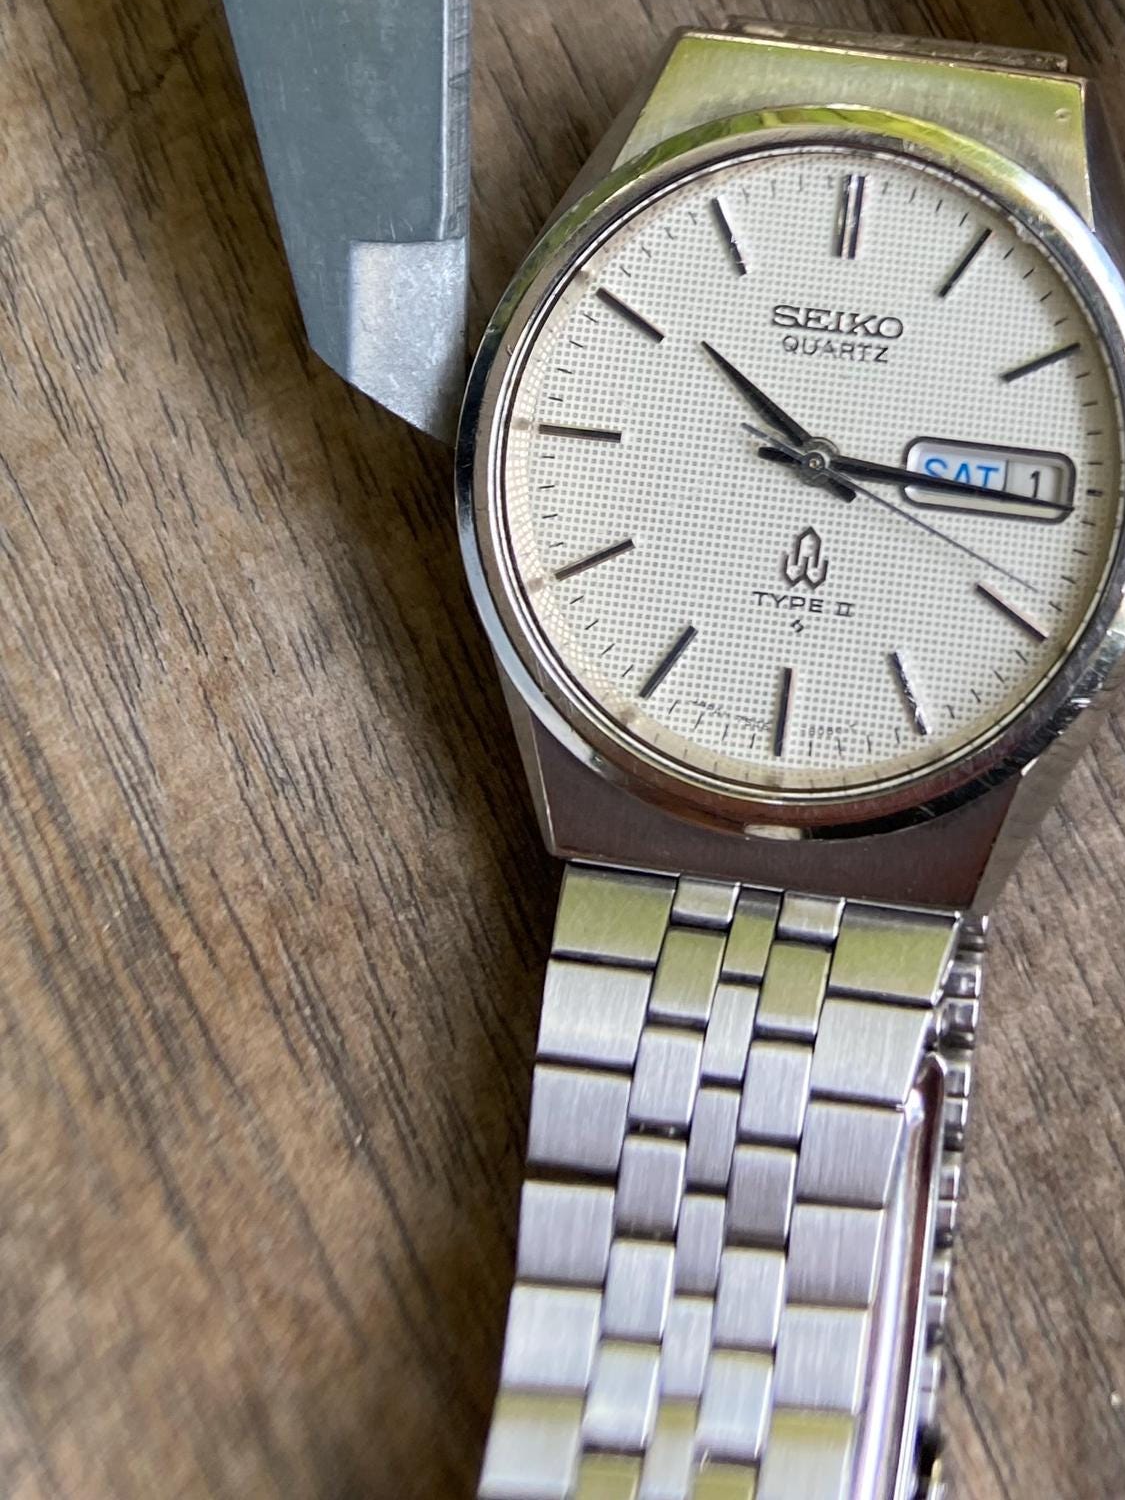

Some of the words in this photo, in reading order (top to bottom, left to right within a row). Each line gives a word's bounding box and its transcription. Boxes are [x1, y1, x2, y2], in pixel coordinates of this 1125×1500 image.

[772, 304, 904, 340] SEIKO
[781, 334, 889, 364] QUARTZ
[923, 457, 1000, 491] SAT
[1029, 470, 1041, 499] 1
[752, 591, 824, 614] TYPE
